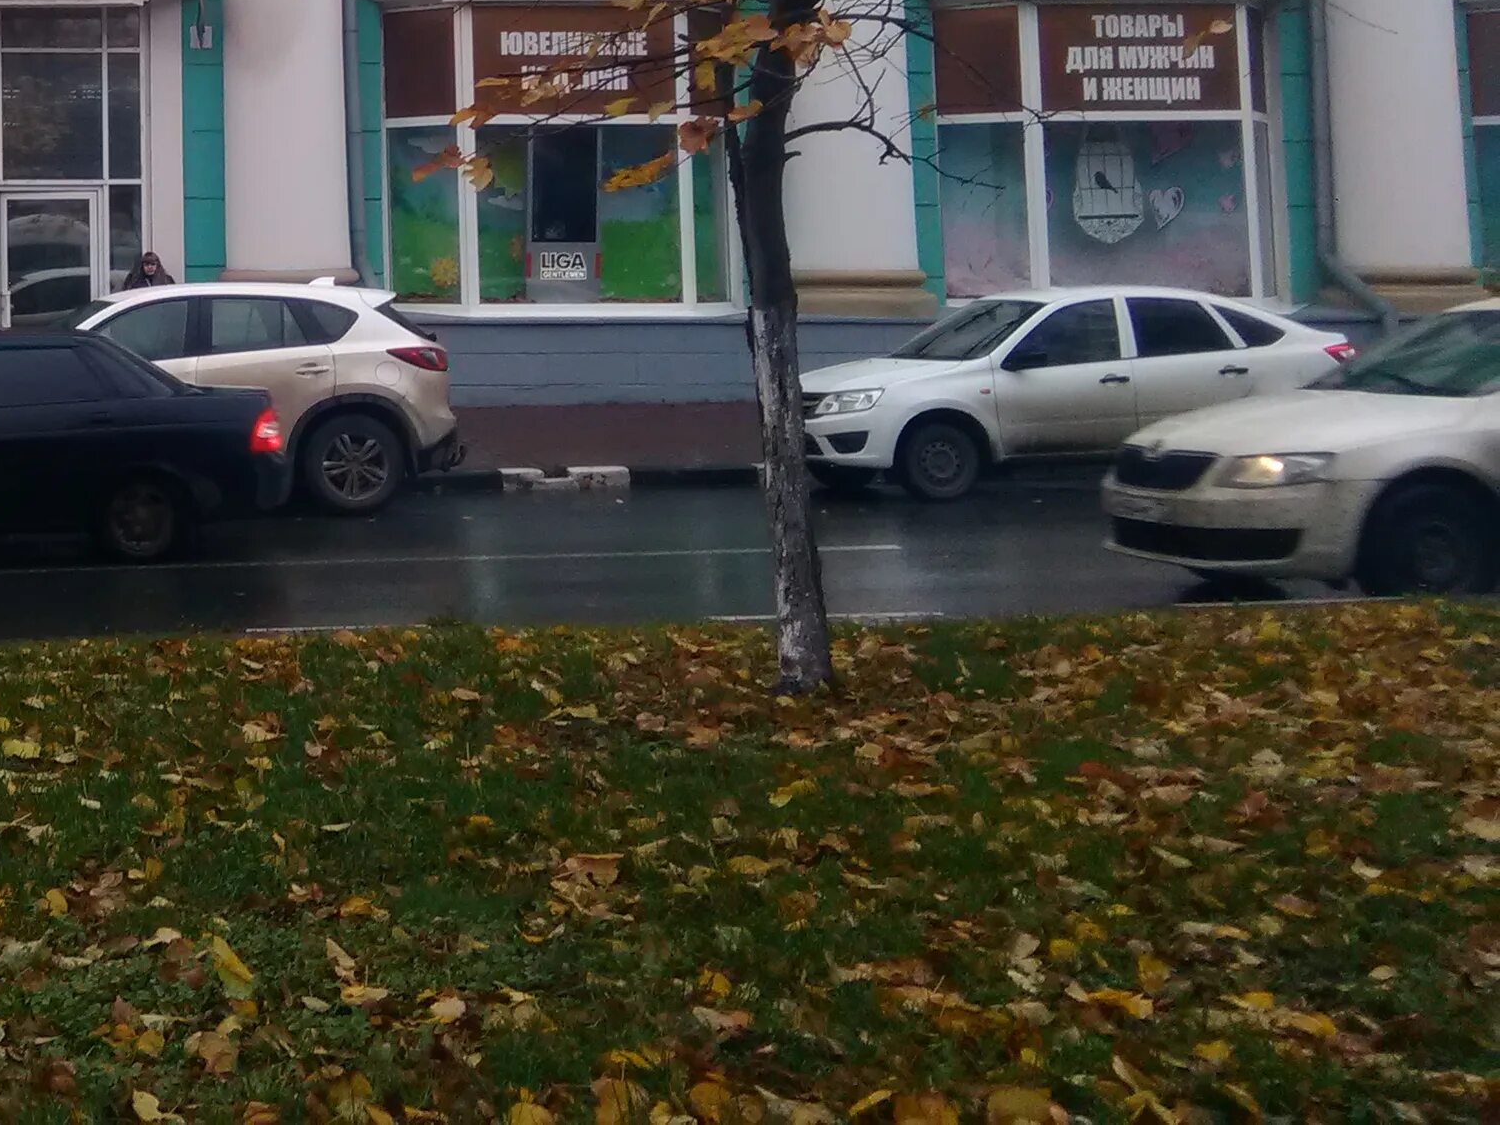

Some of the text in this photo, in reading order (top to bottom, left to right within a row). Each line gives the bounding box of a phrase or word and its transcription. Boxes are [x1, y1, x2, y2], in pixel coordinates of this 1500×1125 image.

[1091, 14, 1185, 39] ТОВАРЫ
[1065, 45, 1216, 73] ДЛЯ МУЖЧИН
[1083, 76, 1201, 104] И ЖЕНЩИН
[540, 251, 586, 270] LIGA
